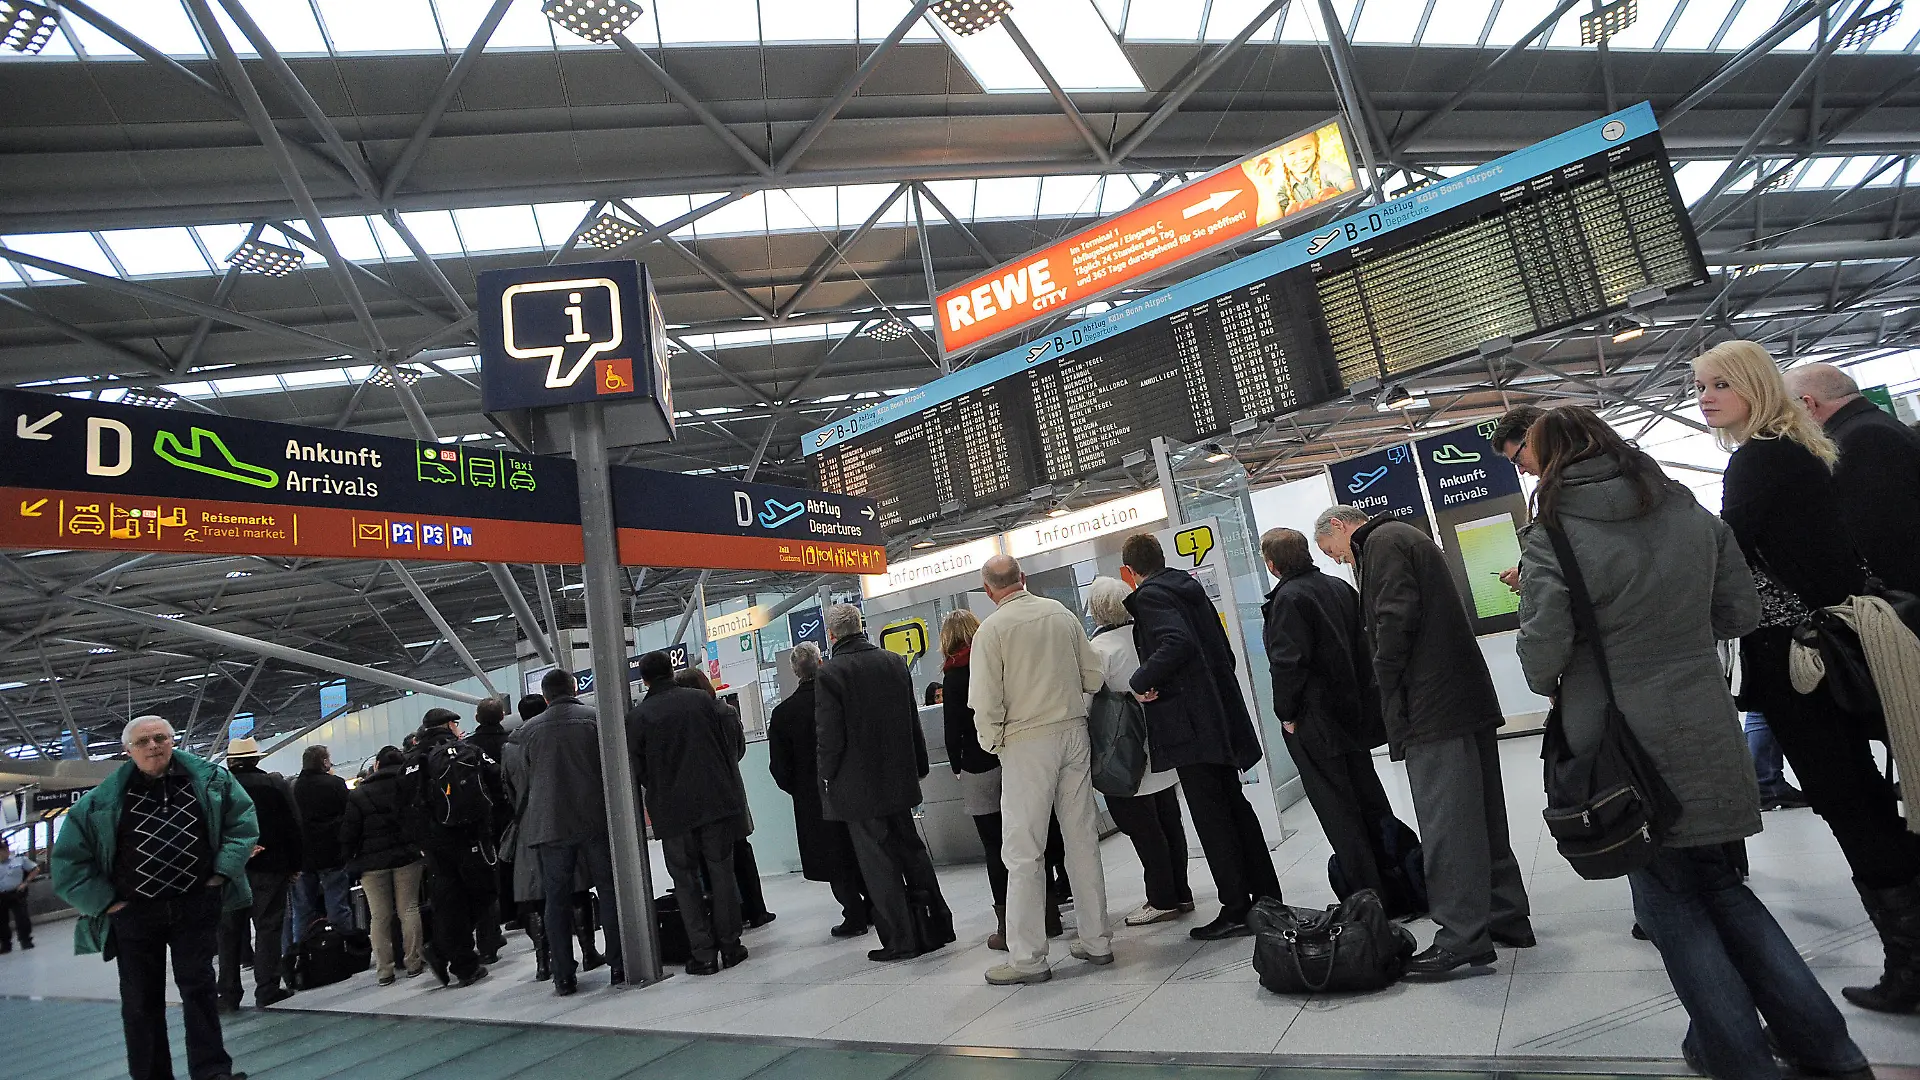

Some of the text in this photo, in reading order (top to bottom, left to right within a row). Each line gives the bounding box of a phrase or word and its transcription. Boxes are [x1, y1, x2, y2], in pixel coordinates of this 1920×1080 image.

[1416, 166, 1504, 204] Köln Bonn Airport
[1383, 202, 1414, 216] Abflug
[1385, 204, 1430, 227] Departure
[1344, 213, 1382, 242] B-D
[1072, 220, 1163, 266] Abflugebene Eingang C
[1080, 232, 1113, 250] Terminal
[1115, 228, 1120, 236] 1
[1074, 230, 1175, 276] Täglich 24 Stunden am Tag
[1076, 211, 1247, 286] und 365 Tage durchgehend für Sie geöffnet!
[946, 258, 1055, 331] REWE
[1032, 287, 1068, 311] CITY
[1108, 294, 1172, 324] Köln Bonn Airport
[1084, 320, 1106, 333] Abflug
[1085, 324, 1118, 342] Departure
[1173, 322, 1193, 335] 11:40
[1175, 329, 1195, 342] 11:55
[1054, 330, 1082, 352] B-D
[1183, 368, 1204, 381] 12:55
[1185, 376, 1206, 388] 13:20
[904, 392, 926, 404] Airport
[1187, 384, 1207, 396] 13:45
[1189, 392, 1209, 404] 14:25
[1191, 399, 1211, 412] 14:45
[1192, 407, 1213, 419] 15:00
[837, 420, 858, 439] B-D
[1194, 415, 1215, 427] 15:00
[86, 417, 132, 476] D
[286, 439, 382, 468] Ankunft
[509, 458, 532, 471] Taxi
[286, 470, 379, 498] Arrivals
[1440, 468, 1487, 489] Ankunft
[1352, 495, 1388, 509] Abflug
[1444, 486, 1488, 505] Arrivals
[734, 491, 753, 526] D
[808, 500, 841, 518] Abflug
[878, 509, 898, 521] ALLORCA
[202, 512, 276, 526] Reisemarkt
[810, 520, 862, 536] Departures
[1036, 505, 1138, 546] Information
[202, 526, 286, 539] Travel market
[887, 552, 973, 587] Information
